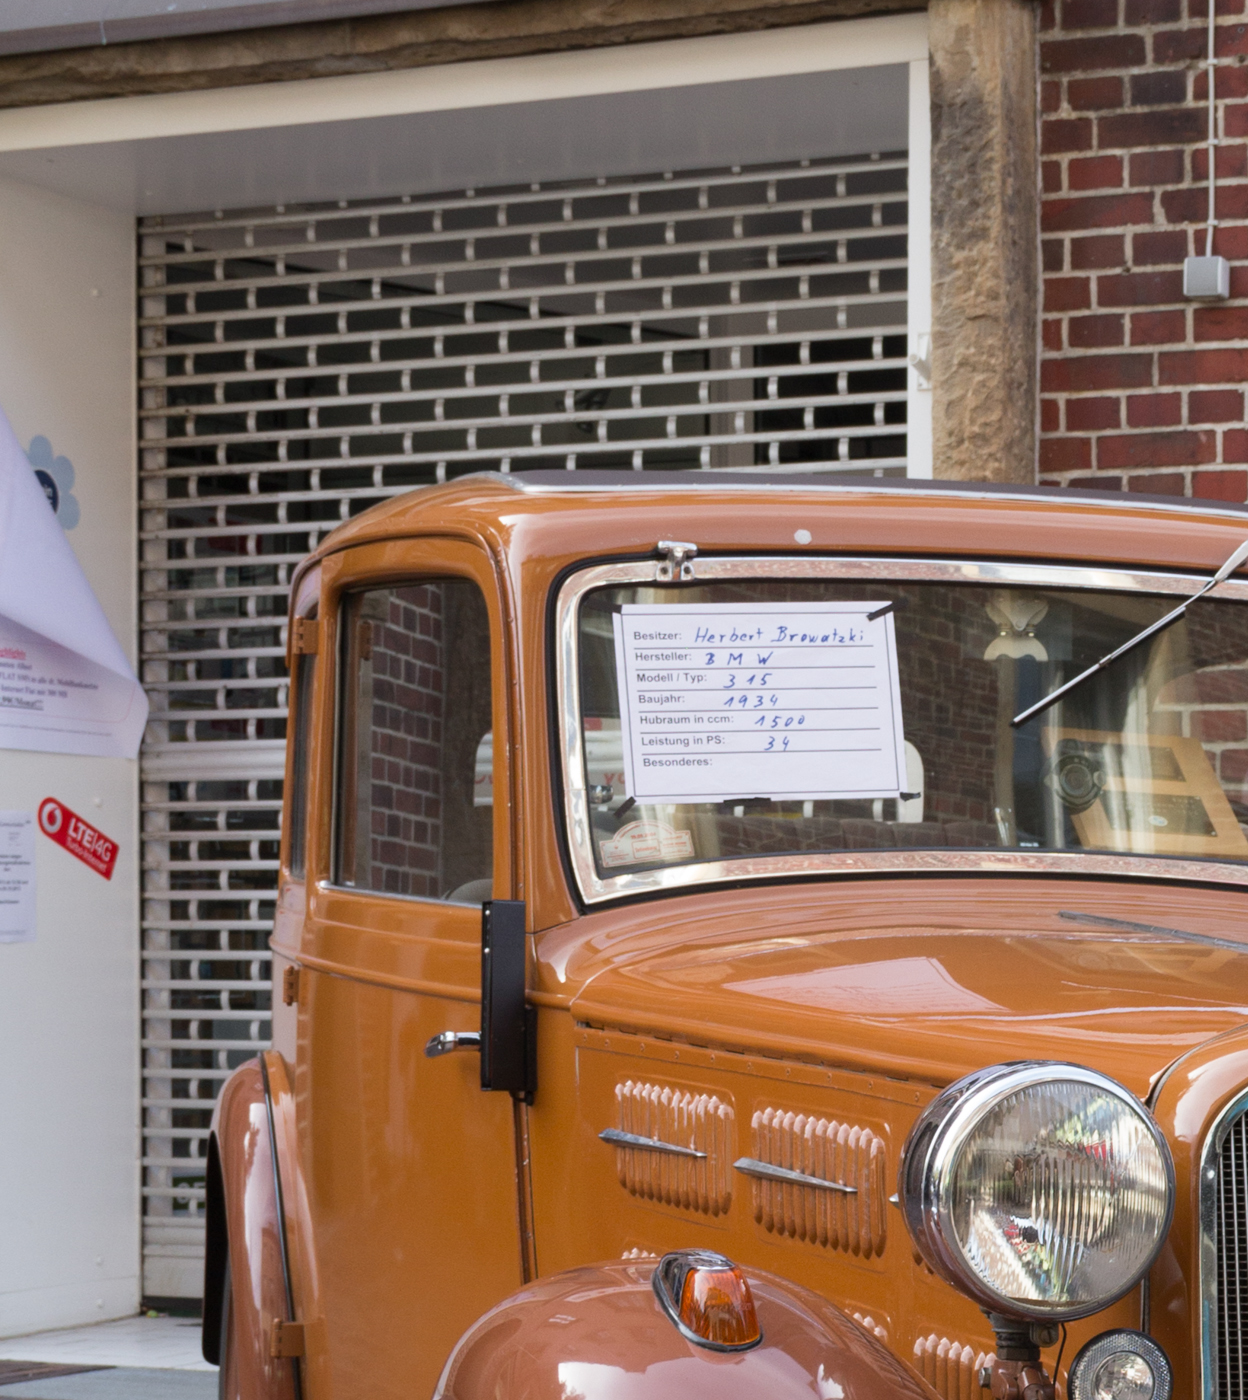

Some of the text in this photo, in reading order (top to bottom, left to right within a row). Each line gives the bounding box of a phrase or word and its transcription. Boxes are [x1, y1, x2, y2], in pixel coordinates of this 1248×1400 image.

[633, 631, 682, 641] Besitzer:
[694, 626, 764, 643] Herbert
[635, 652, 692, 661] Hersteller:
[636, 673, 673, 683] Modell
[683, 672, 707, 684] Typ:
[638, 693, 779, 708] Baujahr: 1934
[640, 714, 806, 728] Hubraum in ccm: 1500
[641, 735, 790, 751] Leistung in PS: 34
[643, 757, 713, 767] Besonderes:
